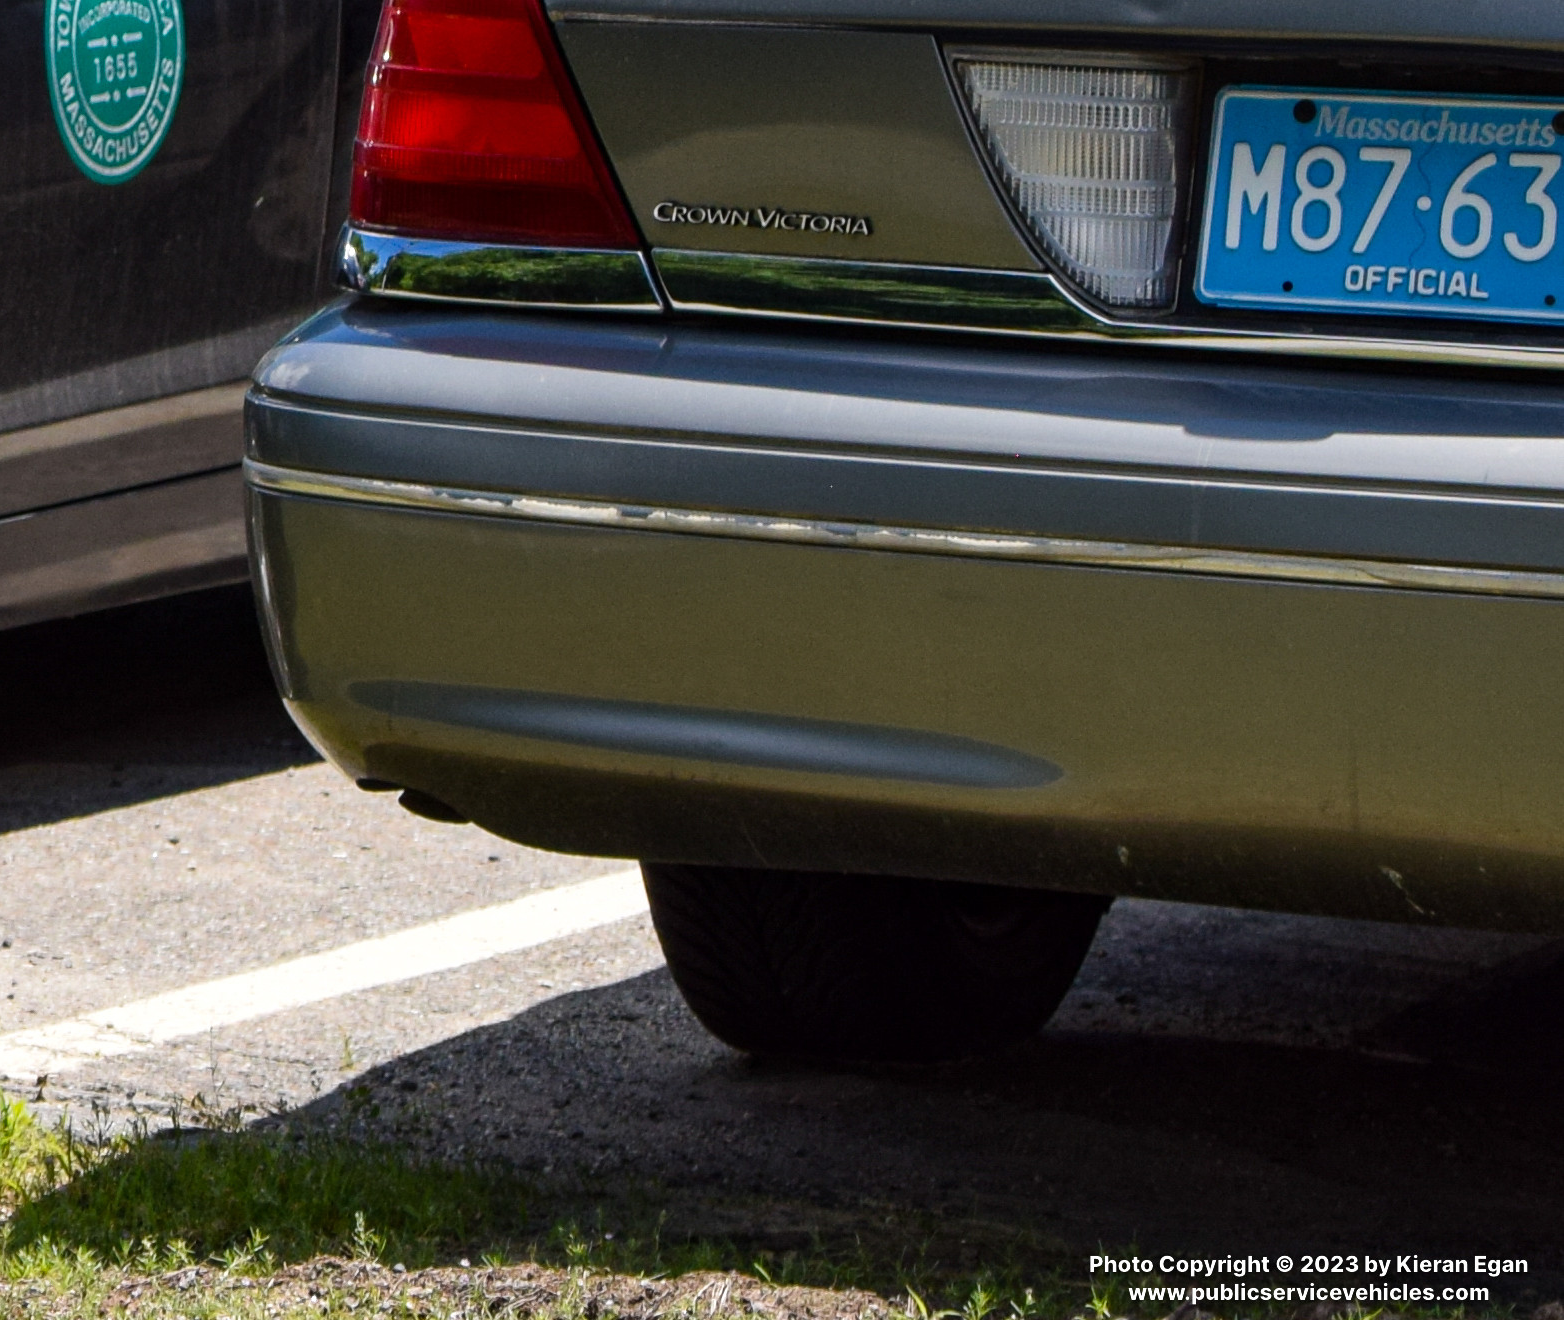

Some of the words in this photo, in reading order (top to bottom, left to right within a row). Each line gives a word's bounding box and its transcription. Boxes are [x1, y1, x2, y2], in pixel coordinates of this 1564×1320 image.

[78, 0, 151, 34] INCORPORATED
[93, 51, 138, 84] 1655
[59, 57, 175, 163] MASSACHUSETTS
[1315, 105, 1557, 148] Massachusetts
[1344, 264, 1489, 299] OFFICIAL
